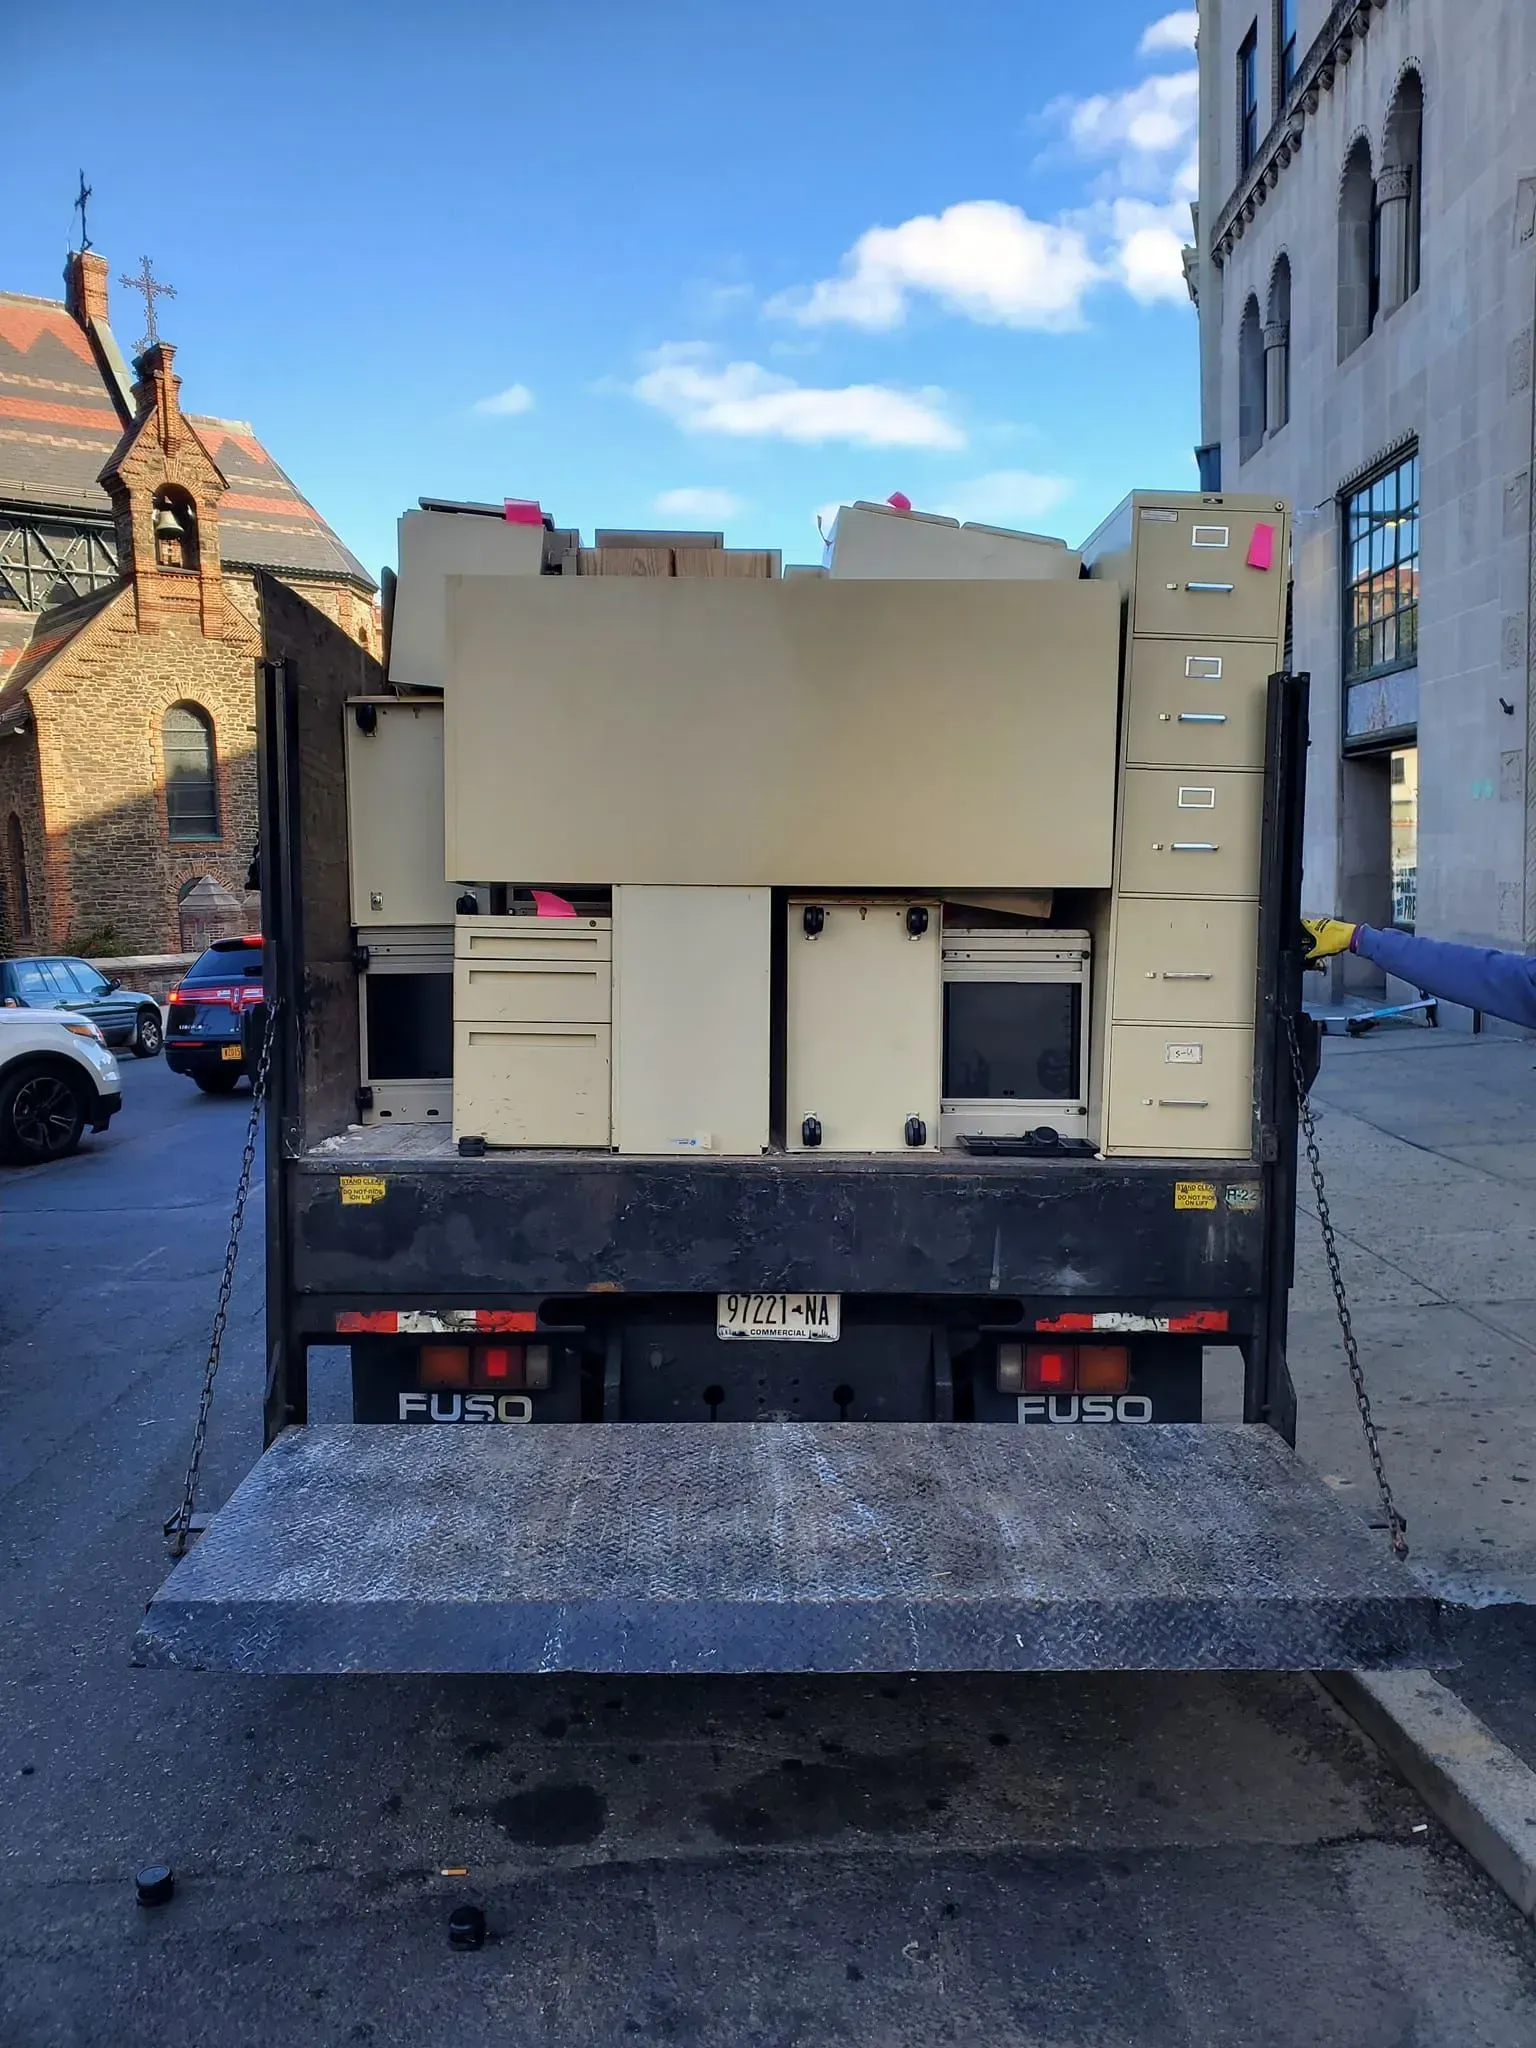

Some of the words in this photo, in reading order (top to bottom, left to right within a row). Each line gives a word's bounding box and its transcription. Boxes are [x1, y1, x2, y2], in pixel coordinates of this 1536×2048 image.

[1177, 1184, 1196, 1192] STAND
[1197, 1184, 1217, 1192] CLEA
[727, 1294, 787, 1325] 97221
[805, 1295, 829, 1326] NA
[750, 1328, 807, 1337] COMMERCIAL
[399, 1392, 533, 1424] FUSO
[1017, 1395, 1153, 1425] FUSO
